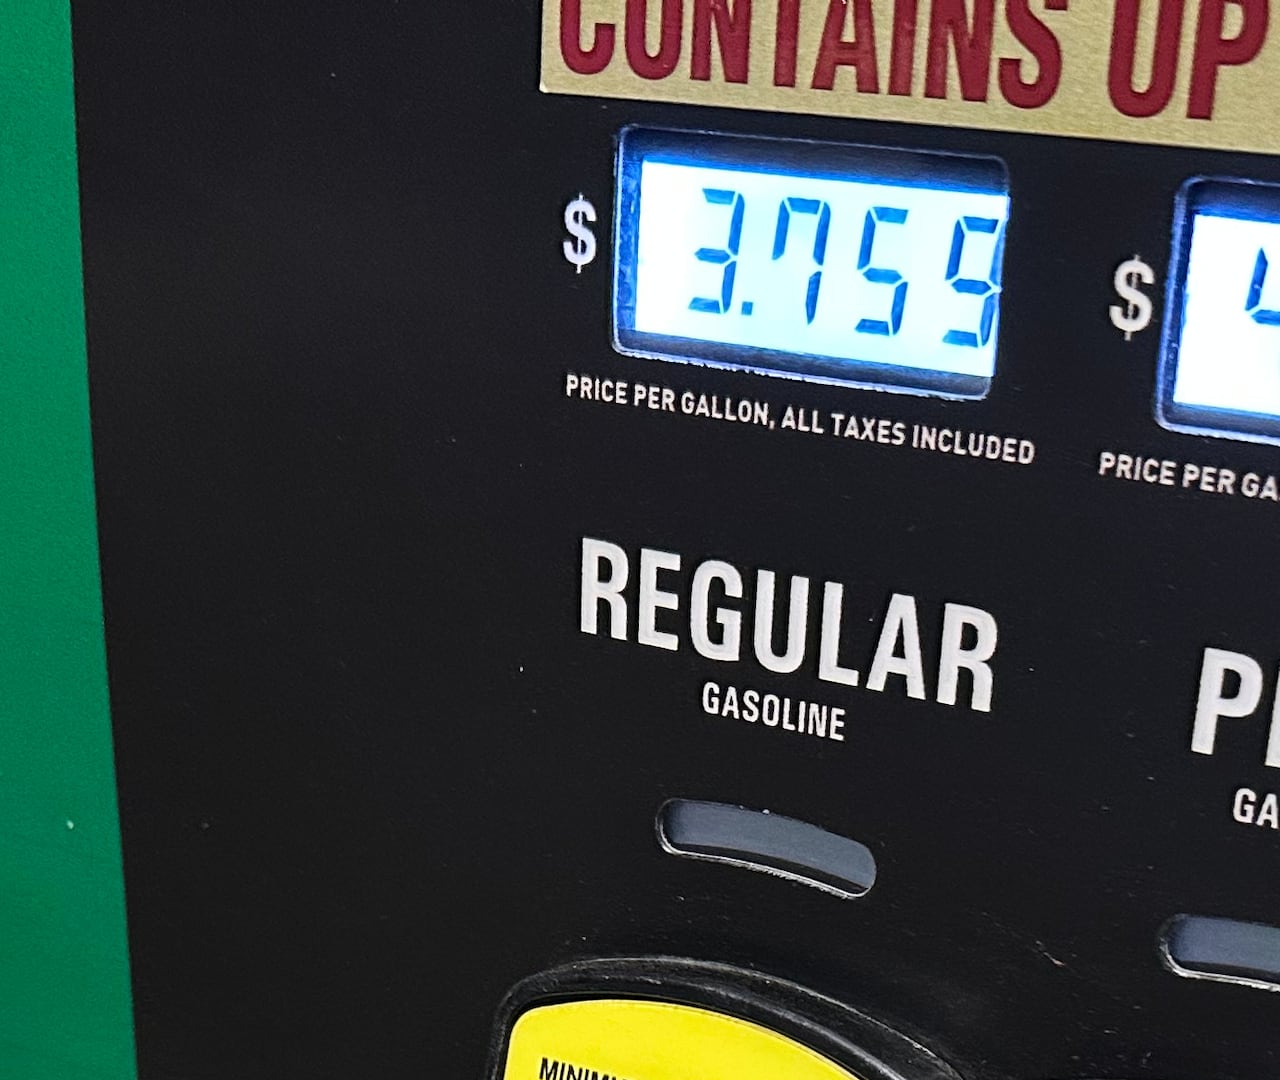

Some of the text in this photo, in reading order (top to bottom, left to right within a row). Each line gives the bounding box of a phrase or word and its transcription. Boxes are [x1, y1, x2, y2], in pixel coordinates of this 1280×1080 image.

[558, 0, 1064, 109] CONTAINS
[1107, 0, 1270, 120] UP
[562, 187, 1007, 349] $ 3.759
[1109, 254, 1156, 341] $
[565, 373, 1036, 466] PRICE PER GALLON, ALL TAXES INCLUDED
[1098, 451, 1176, 487] PRICE
[1182, 462, 1235, 496] PER
[580, 536, 999, 713] REGULAR
[701, 681, 847, 741] GASOLINE
